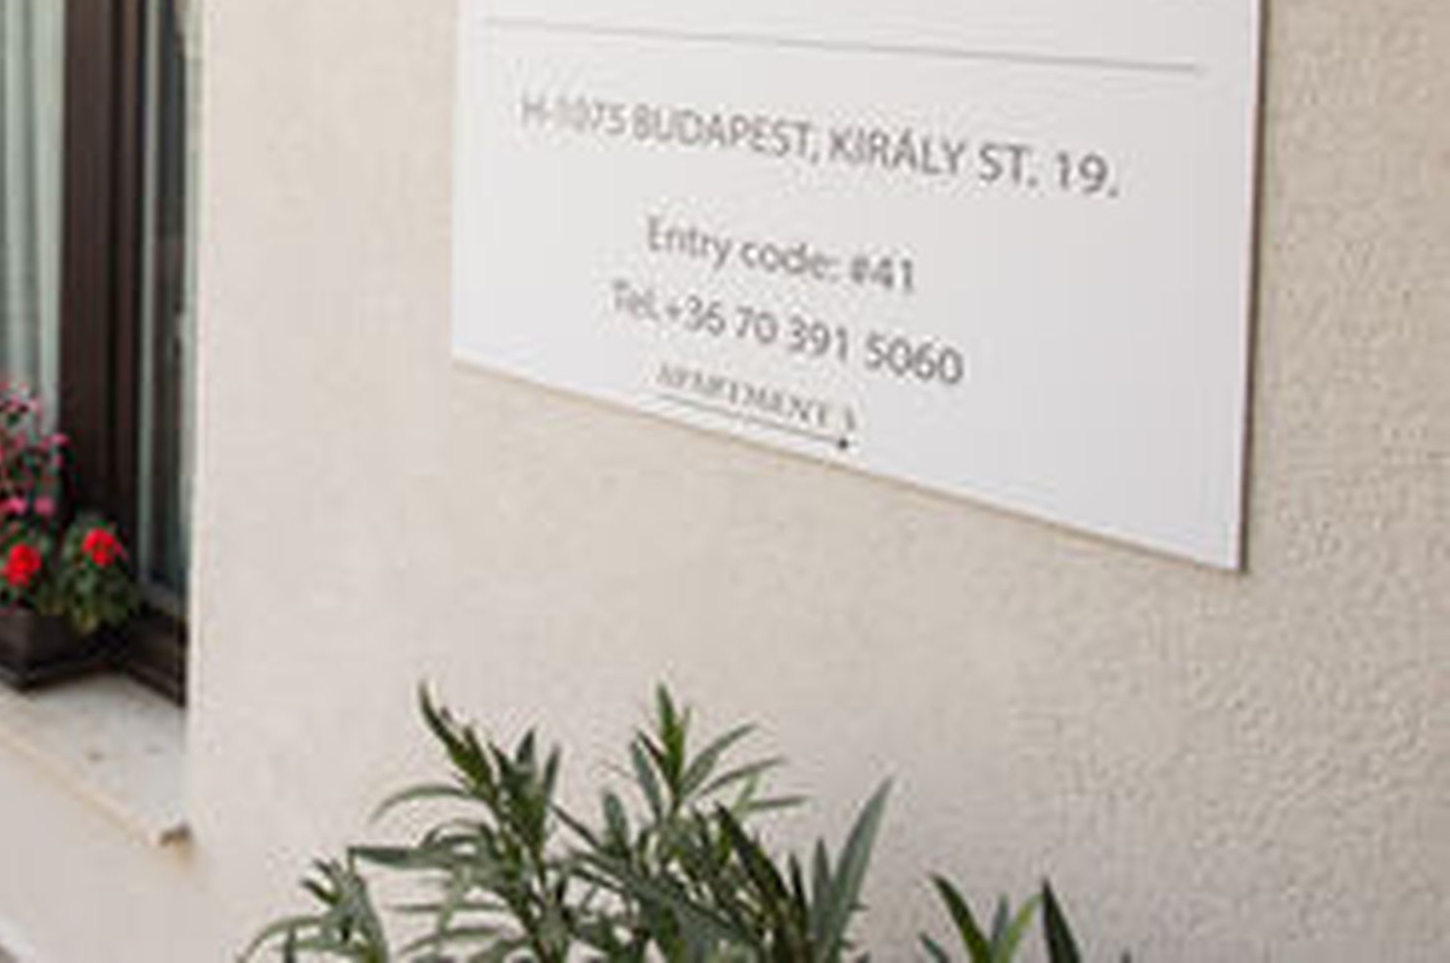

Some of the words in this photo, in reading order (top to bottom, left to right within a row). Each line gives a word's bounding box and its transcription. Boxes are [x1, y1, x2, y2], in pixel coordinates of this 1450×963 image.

[632, 103, 819, 165] BUDAPEST,
[829, 125, 965, 175] KIRÁLY
[978, 142, 1038, 187] ST.
[648, 217, 731, 268] Entry
[740, 240, 839, 283] code:
[735, 306, 779, 345] 70
[789, 318, 849, 362] 391
[864, 331, 965, 386] 5060
